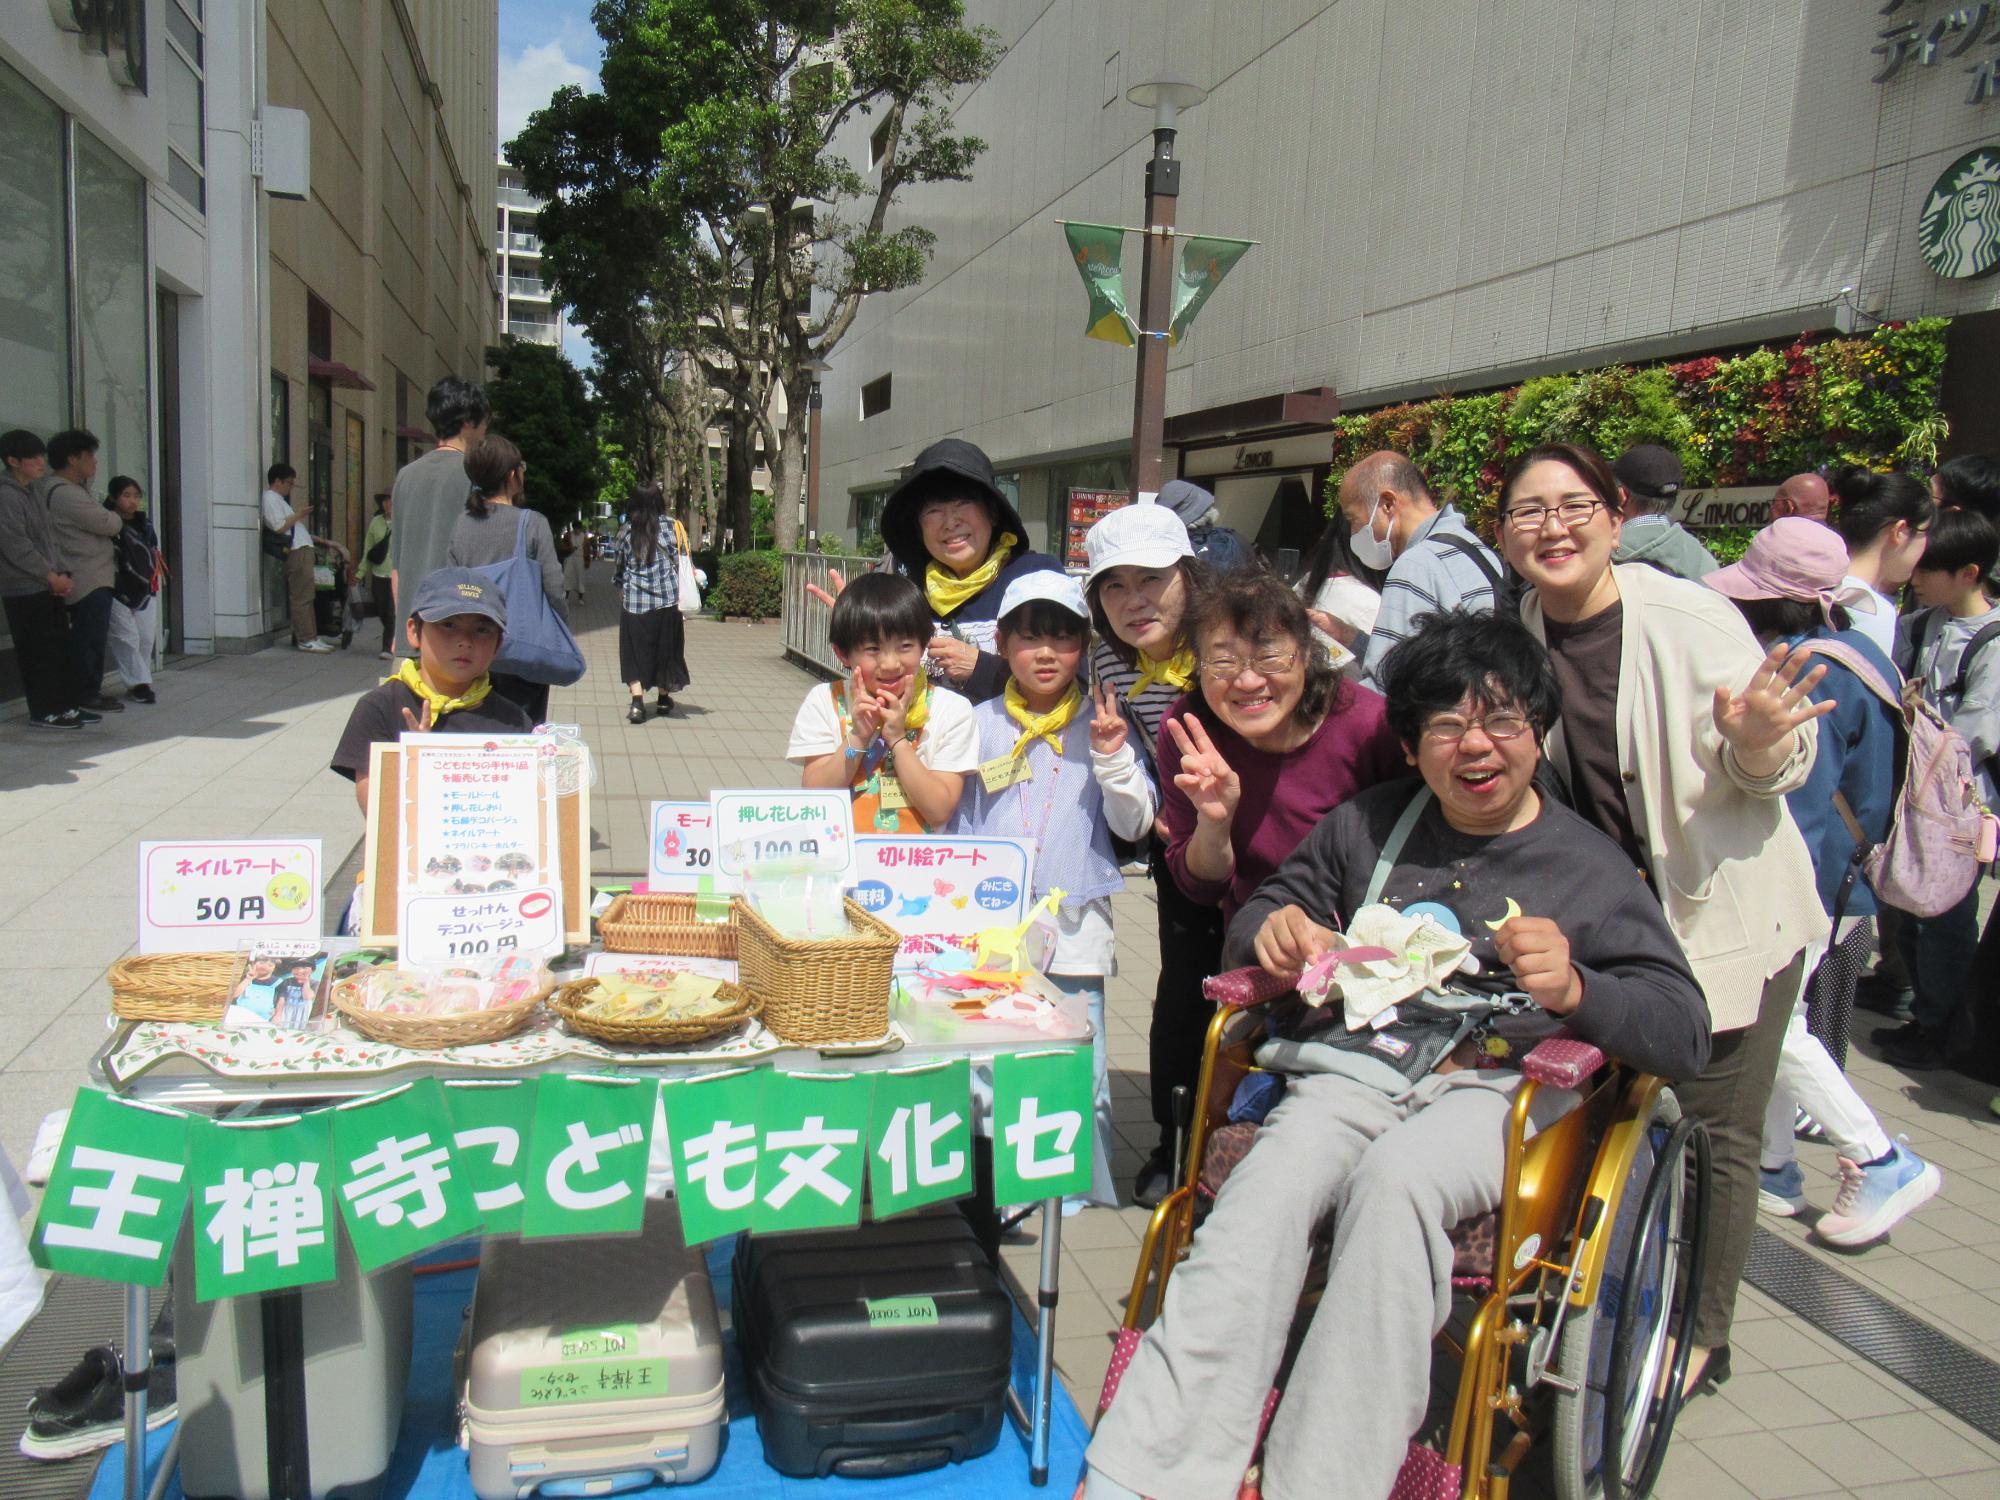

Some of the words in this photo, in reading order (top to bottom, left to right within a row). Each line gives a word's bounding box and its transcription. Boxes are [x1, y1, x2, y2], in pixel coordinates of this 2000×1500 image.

[433, 760, 529, 770] こどもたちの手作り品
[442, 773, 509, 783] を販売してます
[451, 791, 501, 800] モールドール
[738, 805, 827, 823] 押し花しおり
[685, 848, 712, 867] 30
[753, 840, 793, 861] 100
[800, 839, 820, 856] 円
[877, 846, 988, 868] 切り絵アート
[176, 858, 286, 876] ネイルアート
[981, 880, 1013, 893] みにき
[196, 896, 231, 921] 50
[238, 895, 265, 920] 円
[453, 903, 510, 918] せっけん
[448, 939, 490, 958] 100
[497, 934, 519, 953] 円
[43, 1096, 1083, 1276] 王禅寺こども文化セ
[906, 1306, 932, 1318] NOT
